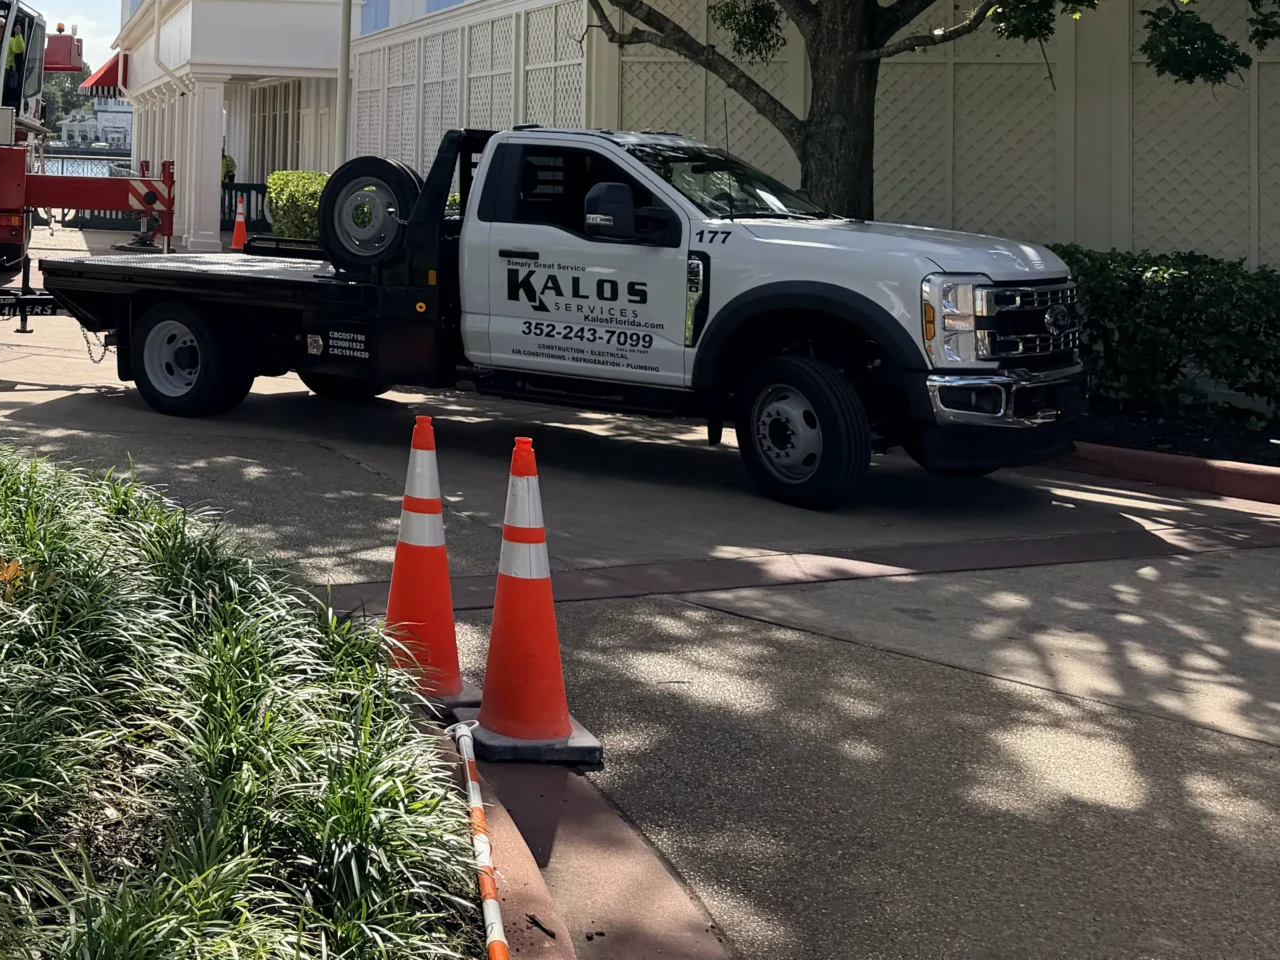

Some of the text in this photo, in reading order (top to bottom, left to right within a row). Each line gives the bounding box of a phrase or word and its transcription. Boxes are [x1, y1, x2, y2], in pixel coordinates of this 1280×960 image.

[695, 229, 732, 244] 177
[507, 259, 587, 272] Simply Great Service
[507, 268, 648, 312] KALOS
[554, 302, 639, 318] SERVICES
[583, 314, 665, 330] KalosFlorida.com
[521, 320, 654, 349] 352-243-7099
[537, 343, 629, 360] CONSTRUCTION ELECTRICAL
[522, 350, 566, 361] CONDITIONING
[571, 356, 621, 368] REFRIGERATION
[626, 363, 660, 373] PLUMBING
